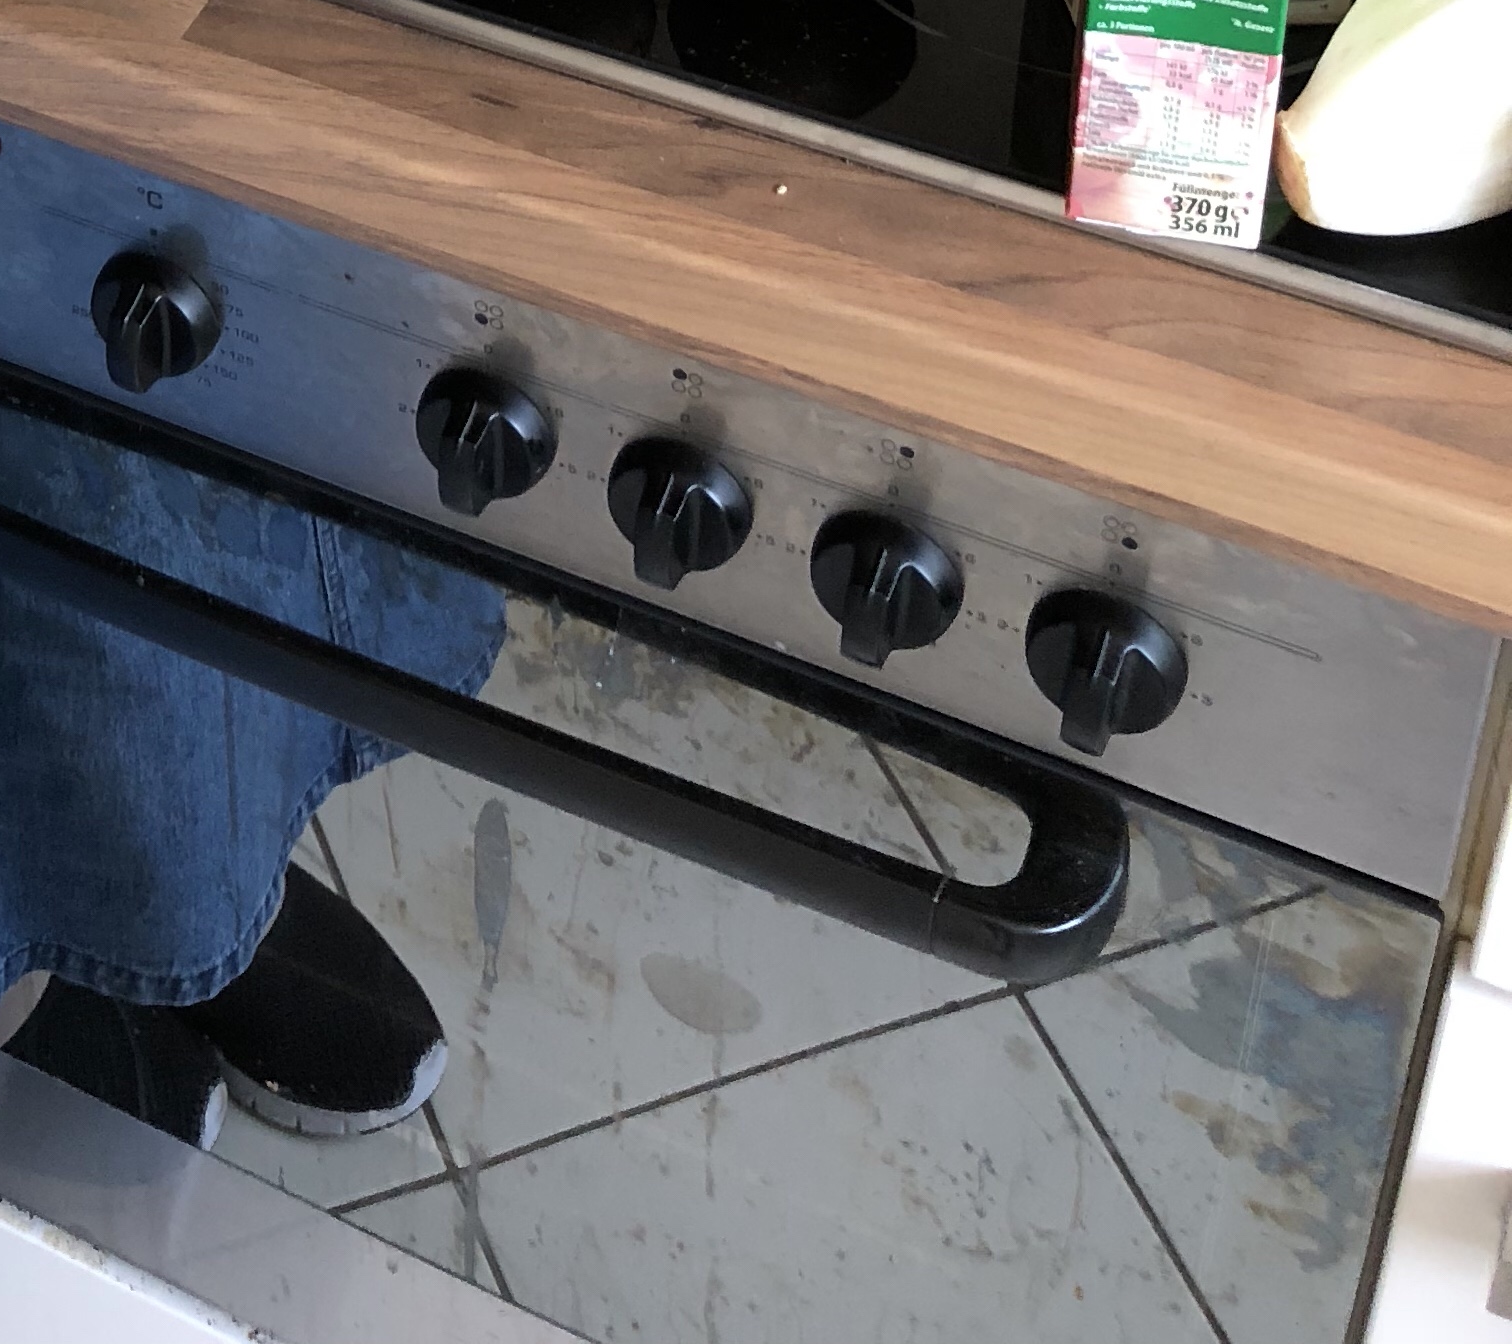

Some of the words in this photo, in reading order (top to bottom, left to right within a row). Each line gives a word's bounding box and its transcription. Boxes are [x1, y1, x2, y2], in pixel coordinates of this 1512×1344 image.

[136, 186, 164, 210] °C
[1169, 194, 1212, 215] 370
[1168, 214, 1209, 235] 356
[1213, 220, 1240, 239] ml
